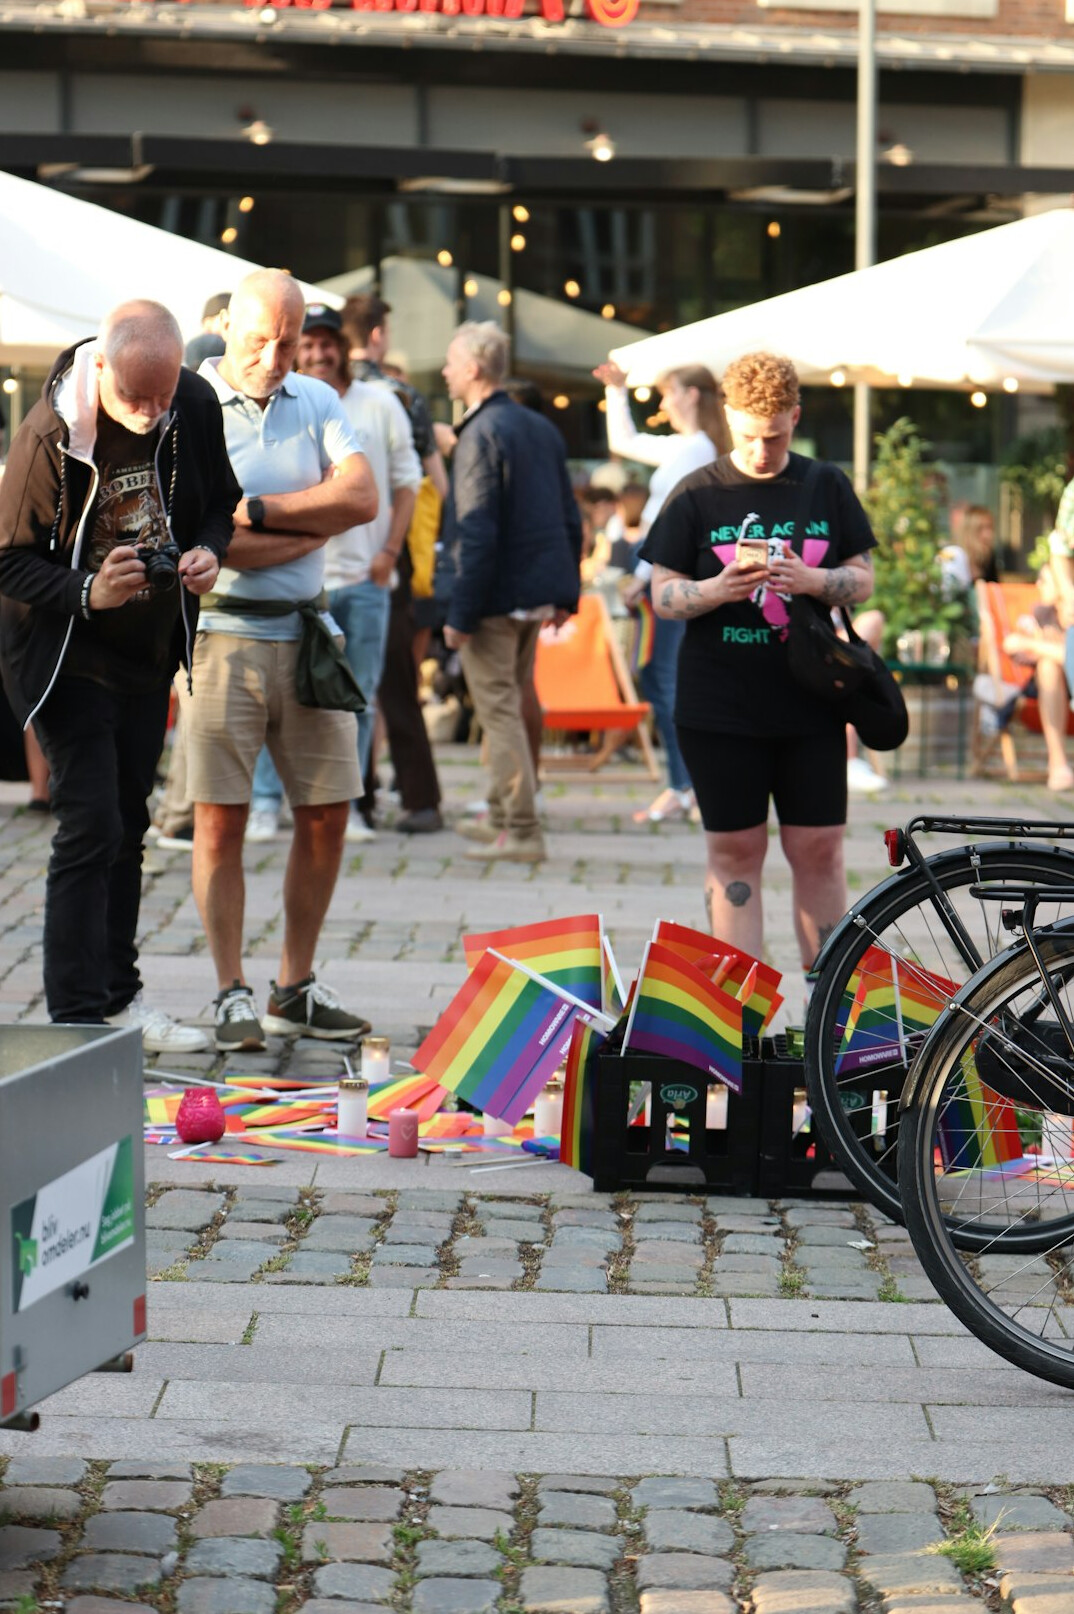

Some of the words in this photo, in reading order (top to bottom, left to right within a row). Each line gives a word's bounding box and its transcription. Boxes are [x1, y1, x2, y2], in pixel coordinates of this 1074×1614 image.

[711, 525, 764, 542] NEVER
[722, 626, 771, 644] FIGHT
[666, 1089, 692, 1100] Arla
